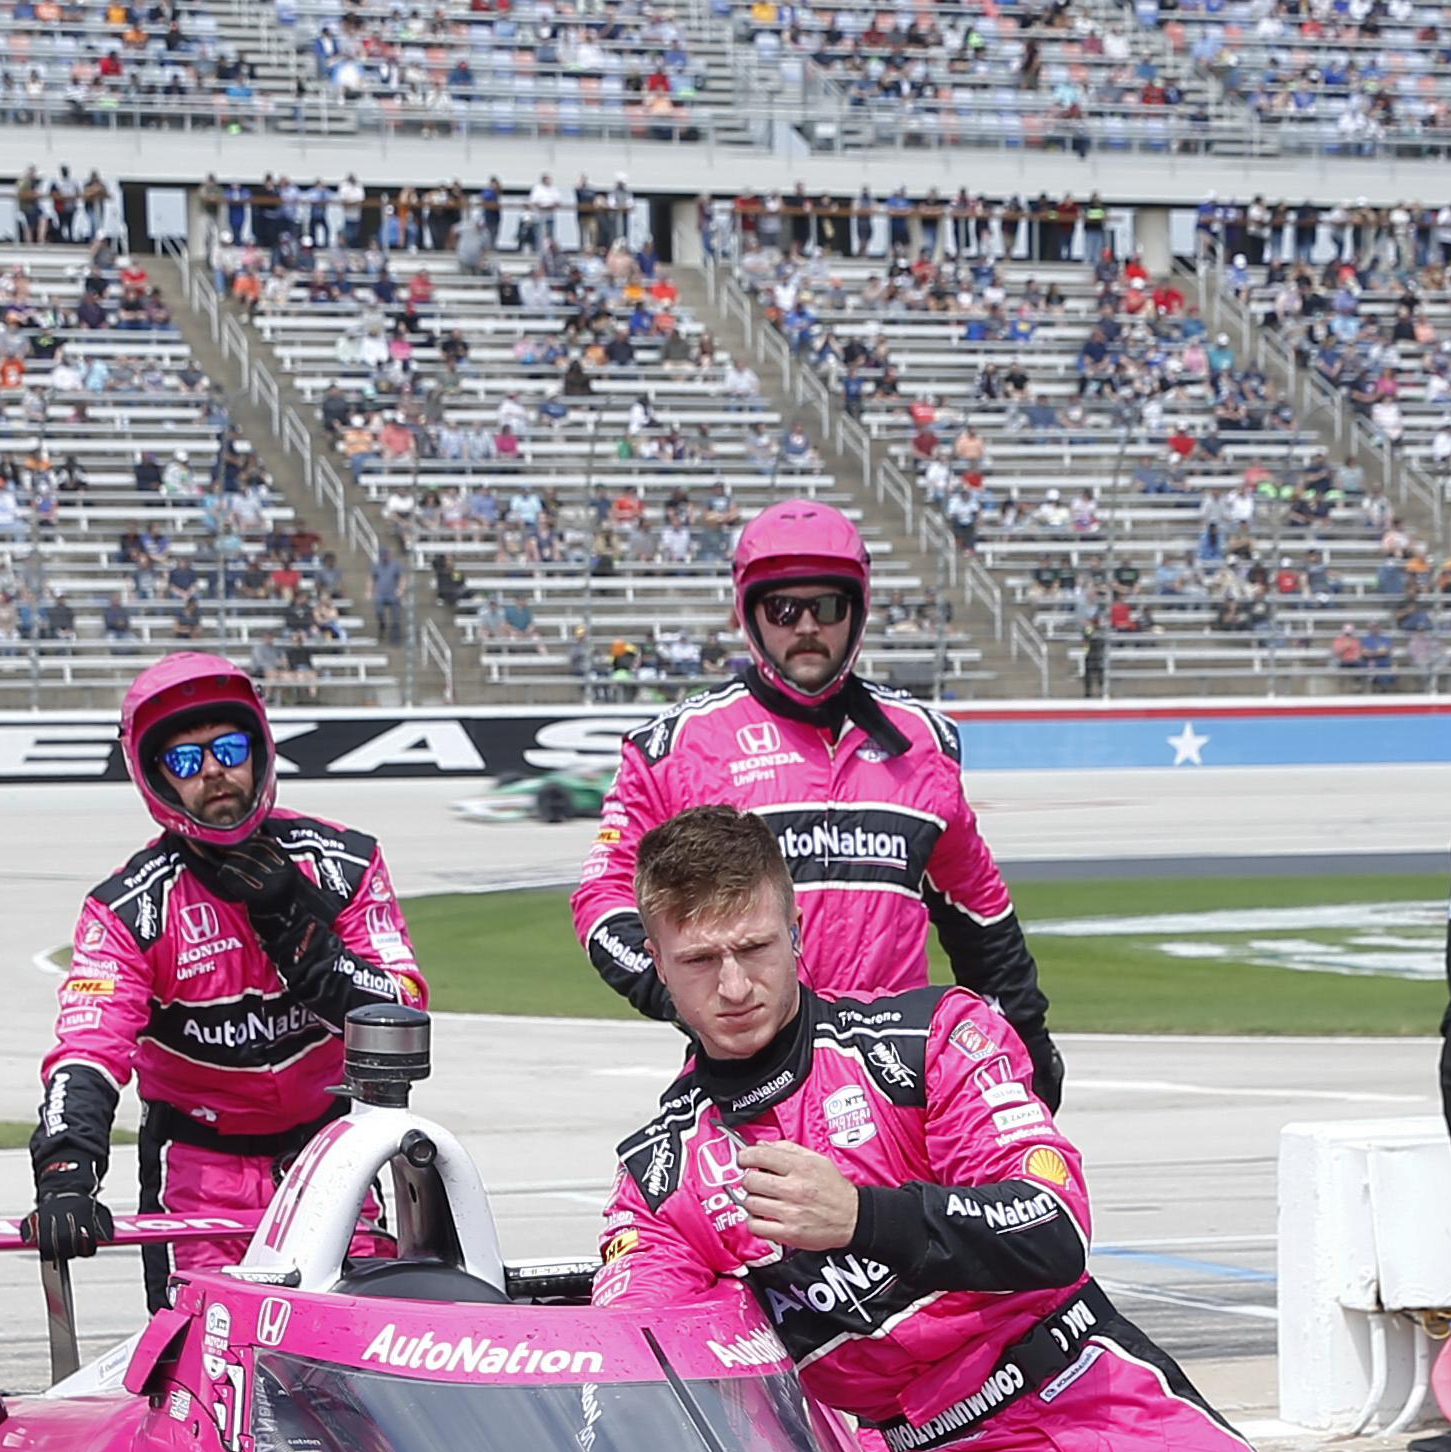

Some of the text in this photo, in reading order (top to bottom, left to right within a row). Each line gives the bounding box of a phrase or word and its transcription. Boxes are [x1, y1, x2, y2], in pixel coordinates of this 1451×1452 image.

[730, 751, 805, 774] HONDA
[778, 823, 908, 858] utoNation
[177, 936, 244, 965] HONDA
[871, 1041, 917, 1089] IMPACT
[732, 1070, 795, 1112] AutoNation
[647, 1140, 671, 1196] IMPACT
[605, 1239, 626, 1261] HL
[361, 1322, 604, 1375] AutoNation
[886, 1362, 1026, 1452] COMMUNICATIONS
